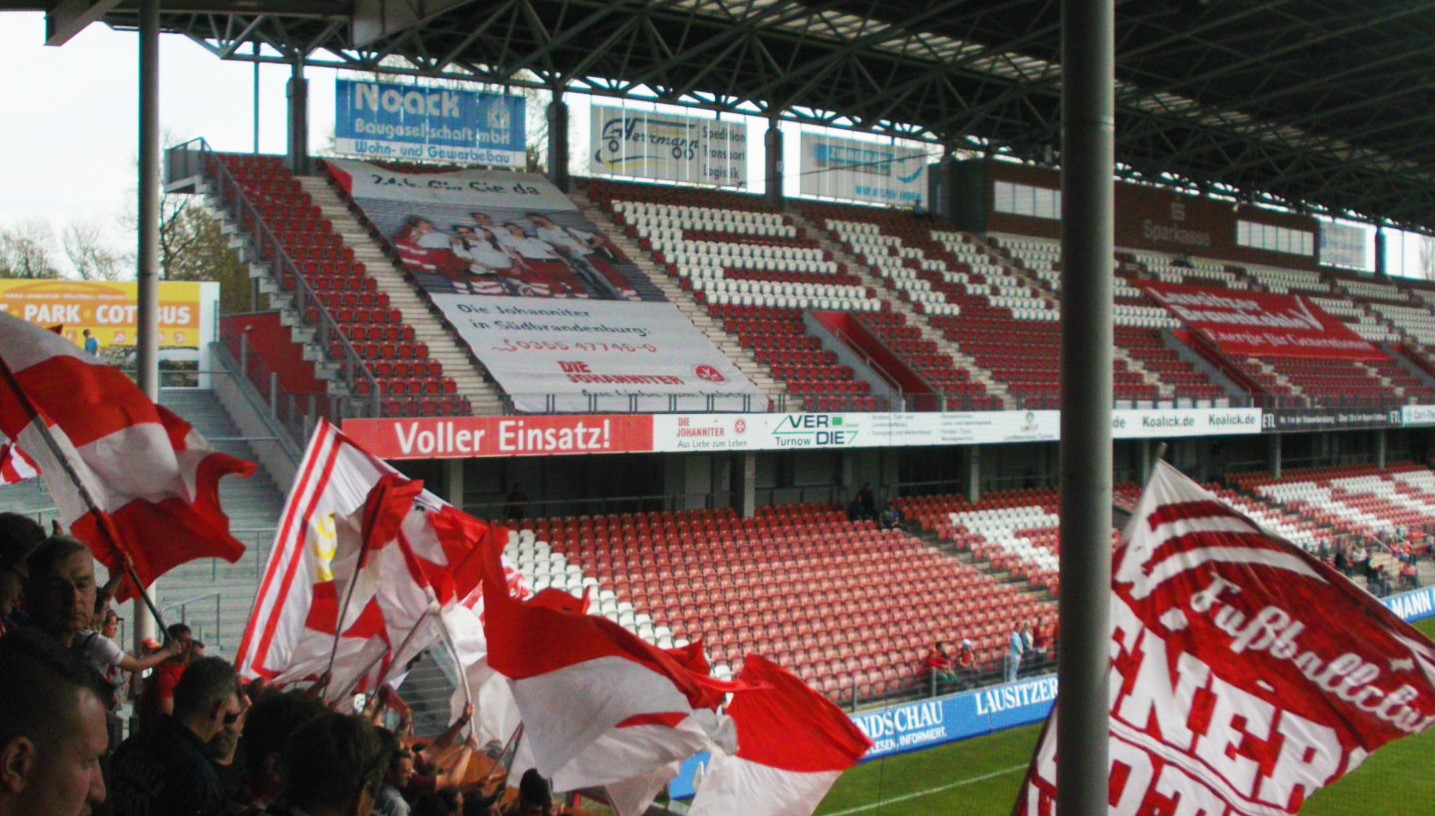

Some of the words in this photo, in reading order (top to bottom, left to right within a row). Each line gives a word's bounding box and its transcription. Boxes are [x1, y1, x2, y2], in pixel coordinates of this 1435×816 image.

[355, 83, 460, 118] Noack
[355, 118, 473, 141] Baugesellschaft
[478, 129, 511, 144] mbH
[702, 126, 745, 143] Spedition
[355, 141, 396, 155] Wohn-
[401, 144, 423, 157] und
[428, 146, 510, 163] Gewerbebau
[703, 145, 745, 161] Transport
[703, 164, 740, 179] Logistik
[1144, 219, 1211, 247] Sparkasse
[24, 304, 81, 324] PARK
[96, 304, 191, 325] COTBUS
[498, 305, 591, 317] Johanniter
[469, 319, 490, 329] in
[494, 320, 651, 337] Südbrandenburg:
[557, 361, 592, 373] DIE
[566, 374, 685, 385] JOHANNITER
[678, 417, 691, 427] DIE
[789, 415, 829, 428] VER
[1142, 415, 1195, 428] Koalick.de
[1208, 412, 1256, 426] Koalick.de
[394, 421, 485, 454] Voller
[499, 419, 612, 452] Einsatz!
[676, 427, 725, 437] JOHANNITER
[816, 431, 845, 445] DIE
[678, 440, 690, 448] Aus
[692, 440, 710, 448] Liebe
[728, 439, 748, 447] Leben
[775, 437, 811, 446] Turnow
[975, 677, 1058, 715] LAUSITZER
[852, 701, 944, 738] NDSCHAU
